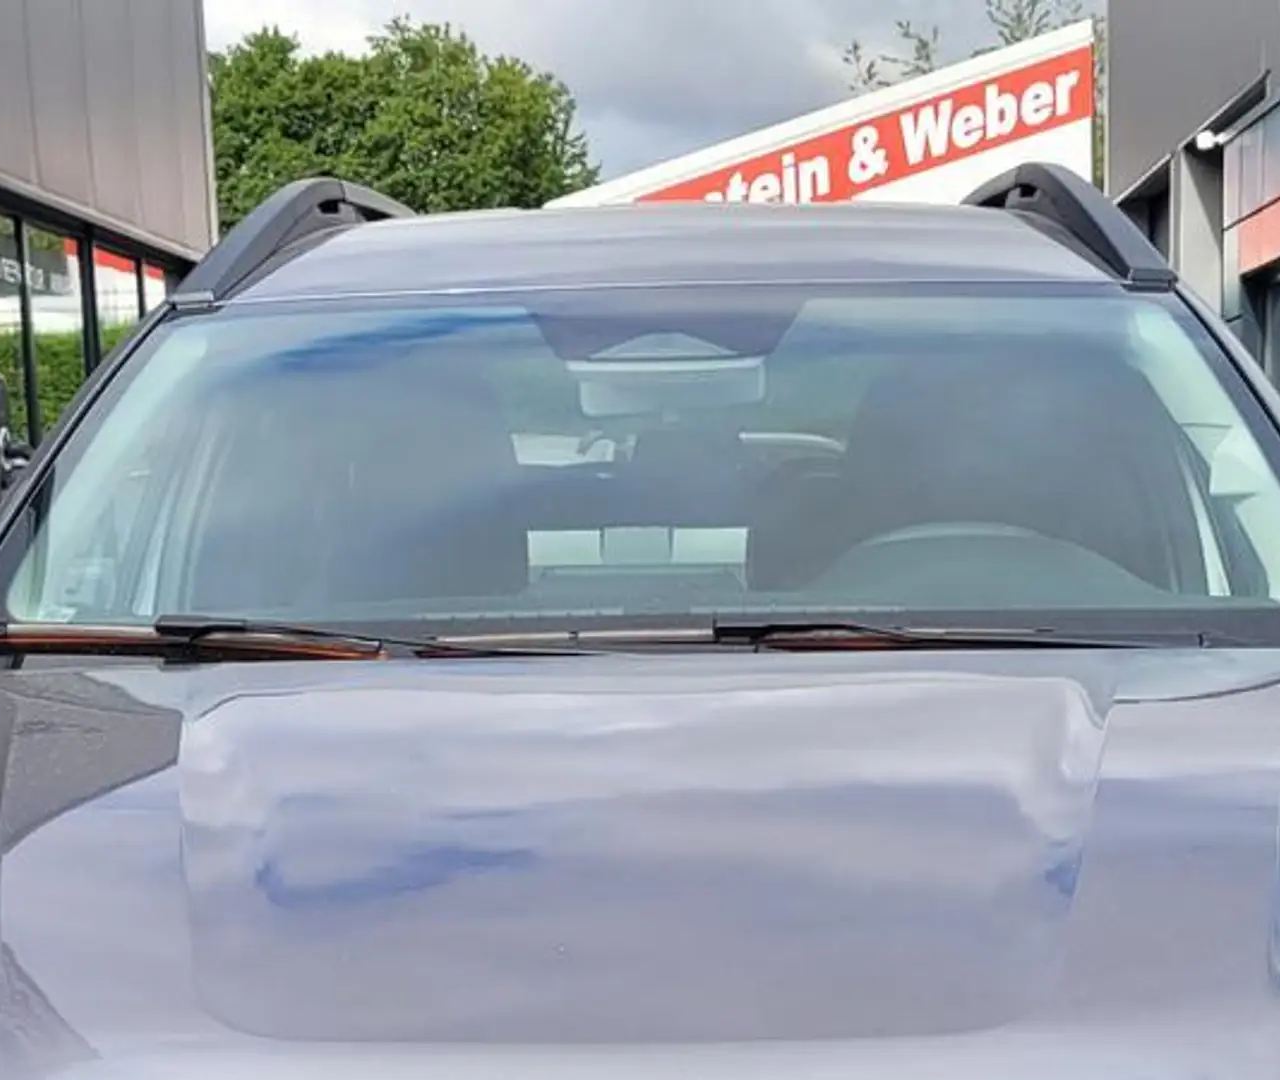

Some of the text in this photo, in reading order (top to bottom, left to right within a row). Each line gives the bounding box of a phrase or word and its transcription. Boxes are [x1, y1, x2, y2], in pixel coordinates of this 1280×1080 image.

[704, 70, 1080, 204] tein & Weber
